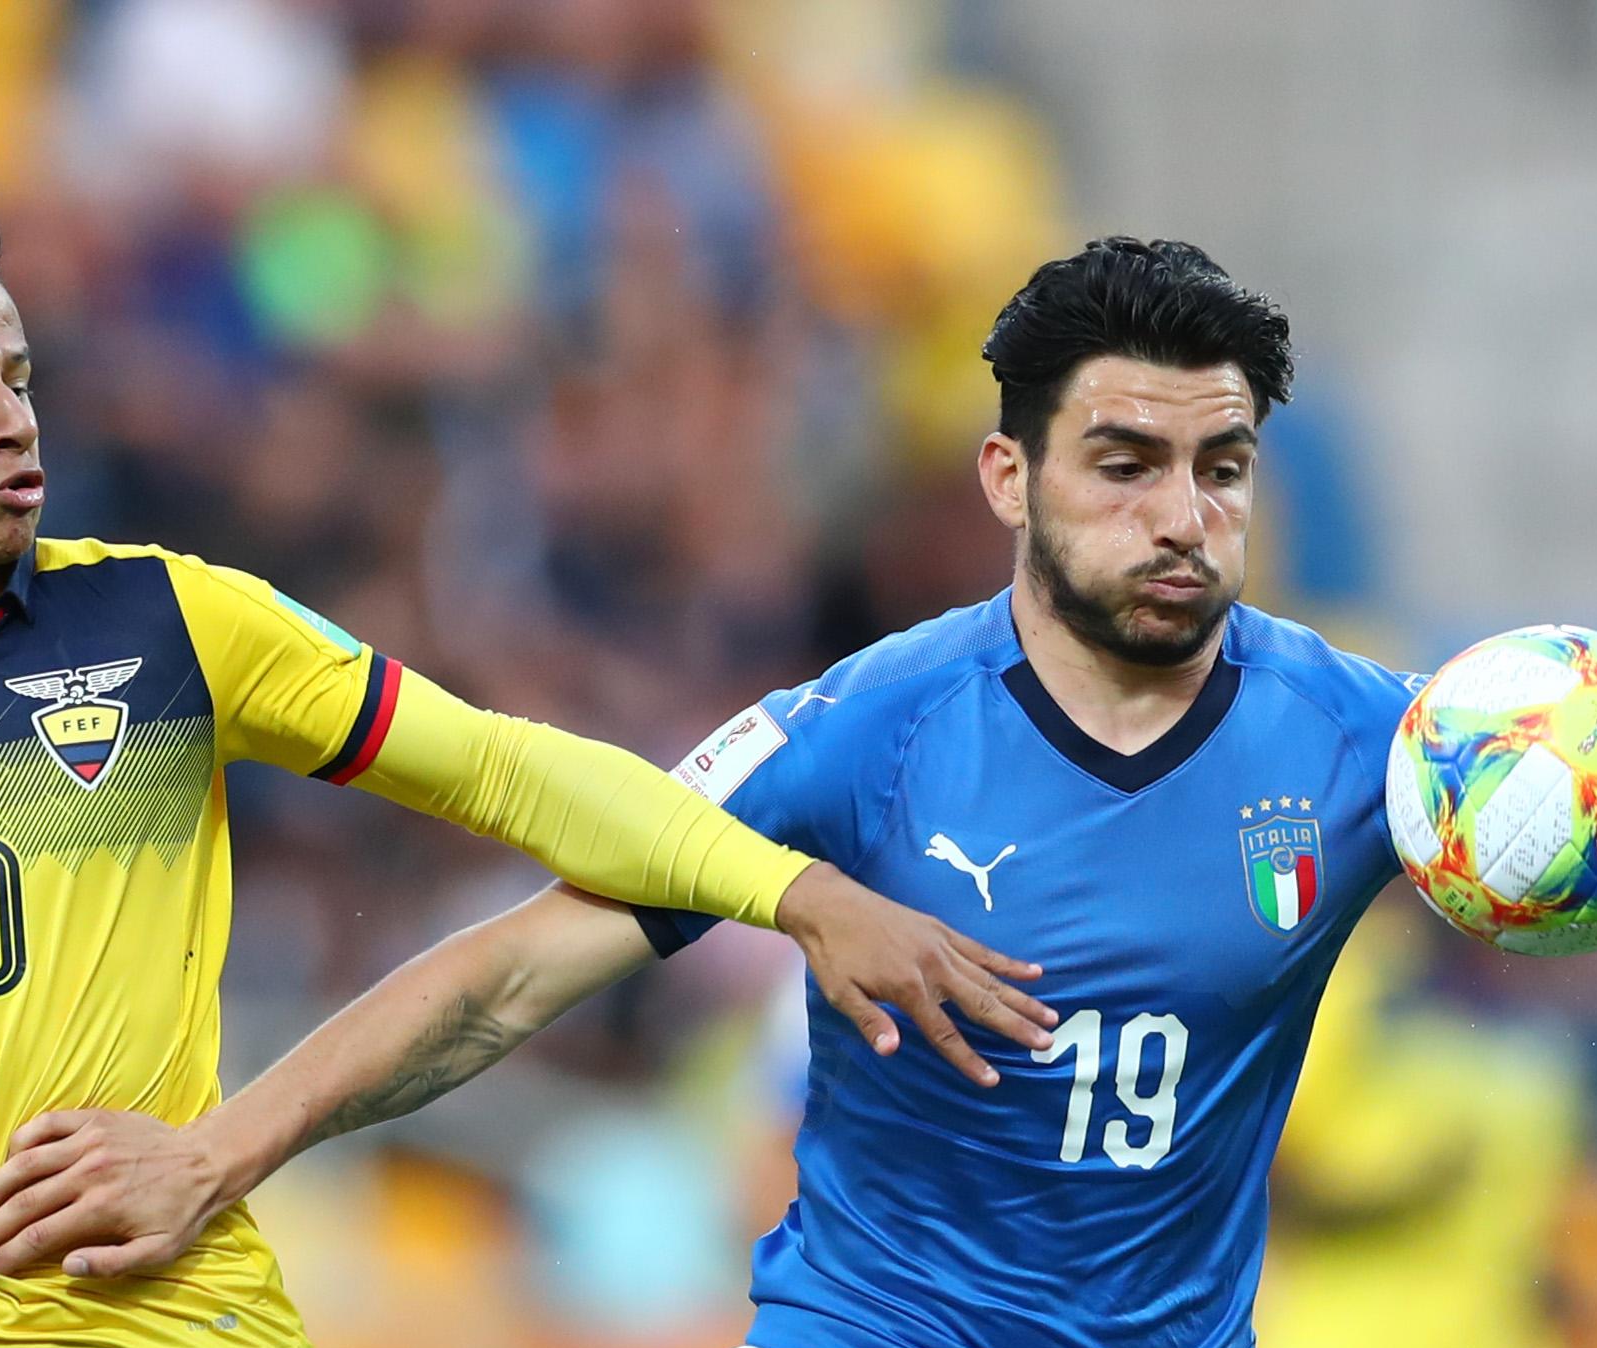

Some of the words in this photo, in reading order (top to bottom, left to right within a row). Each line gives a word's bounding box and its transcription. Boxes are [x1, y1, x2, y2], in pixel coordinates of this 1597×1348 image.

[62, 717, 101, 733] FEF
[1248, 827, 1313, 852] ITALIA
[1030, 1009, 1190, 1171] 19
